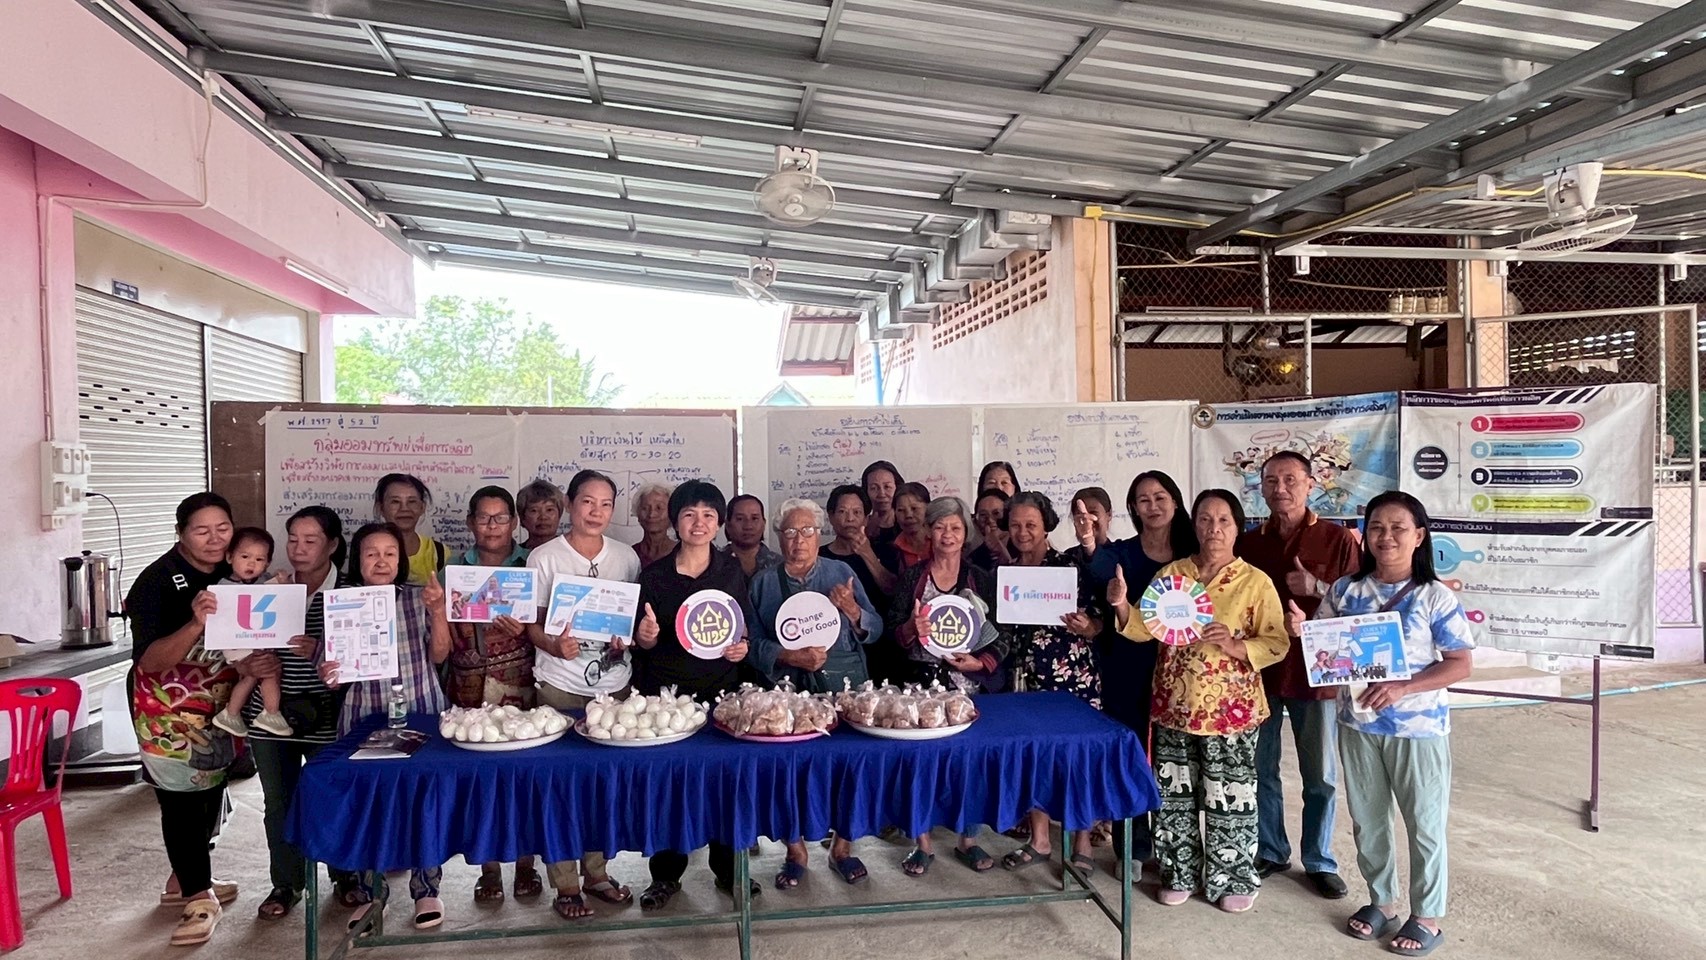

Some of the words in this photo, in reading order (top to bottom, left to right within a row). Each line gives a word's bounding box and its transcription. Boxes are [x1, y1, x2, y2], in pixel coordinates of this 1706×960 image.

[1216, 401, 1388, 422] การดำเนินงานกลุ่มออมทรัพย์เพื่อการผลิต
[1477, 419, 1482, 429] 1
[314, 432, 473, 455] กลุ่มออมทรัพย์เพื่อการผลิต
[1438, 549, 1443, 561] 1
[801, 627, 815, 636] for
[815, 617, 838, 631] Good
